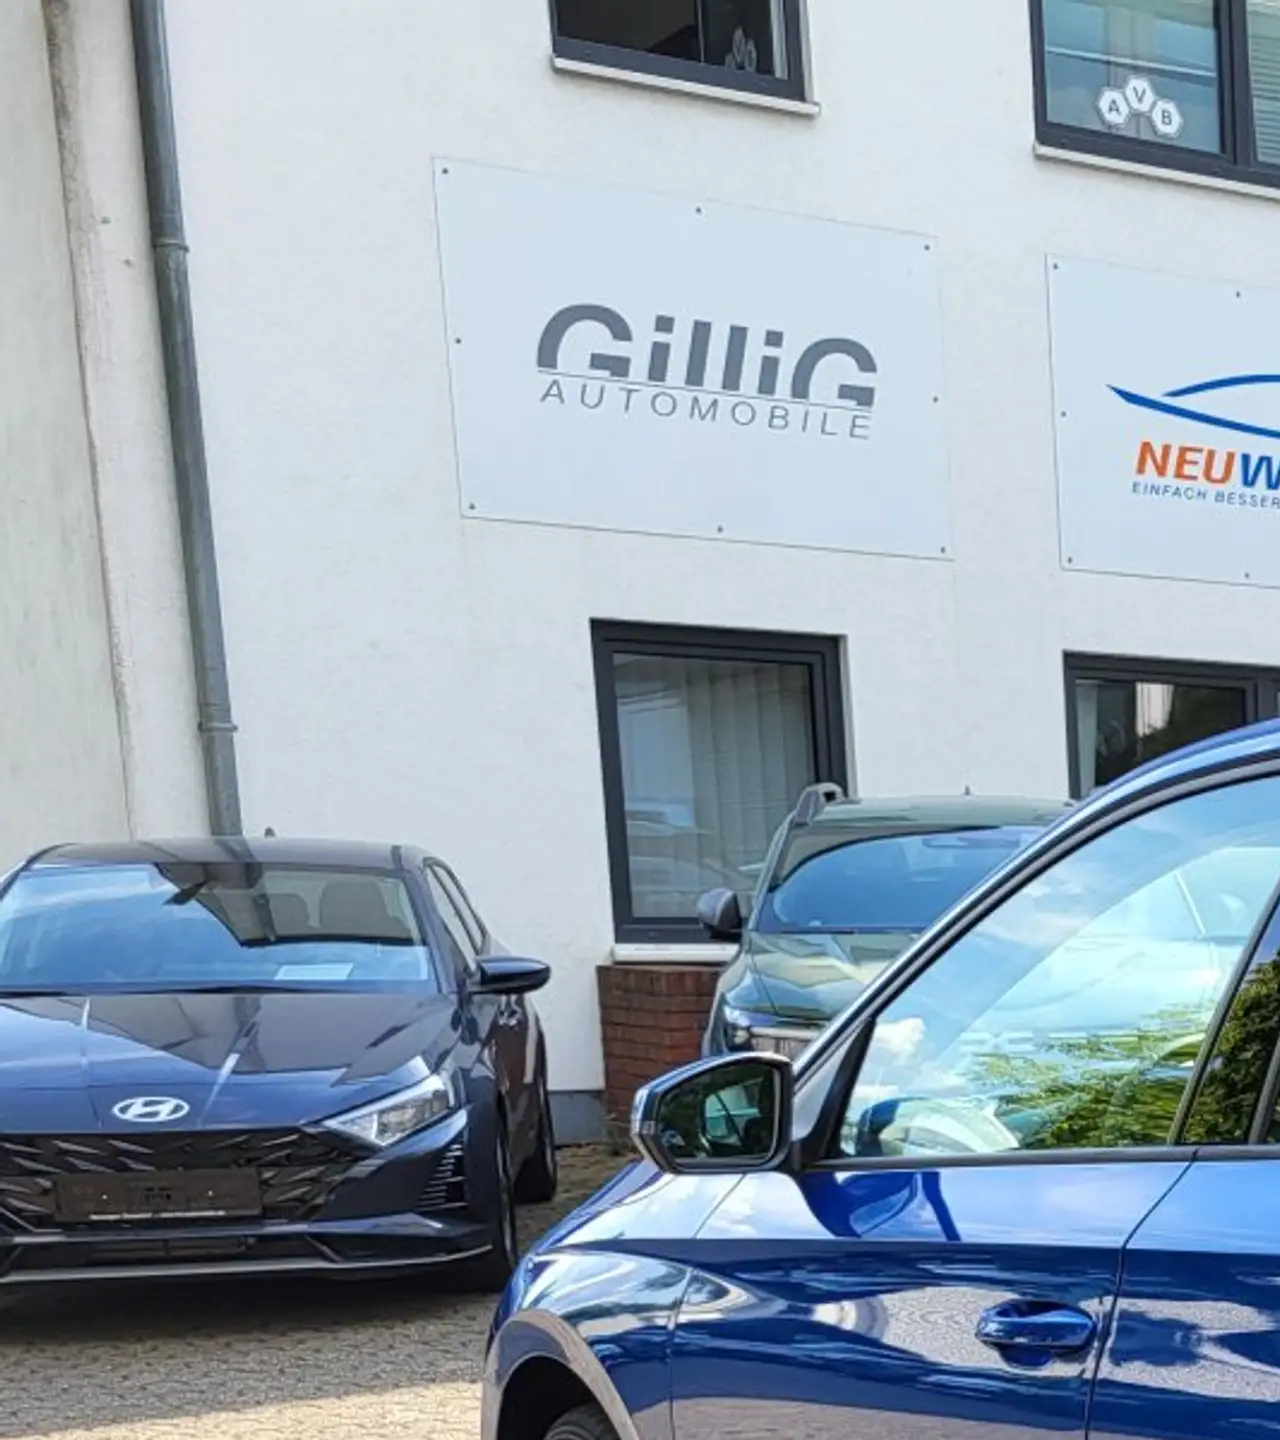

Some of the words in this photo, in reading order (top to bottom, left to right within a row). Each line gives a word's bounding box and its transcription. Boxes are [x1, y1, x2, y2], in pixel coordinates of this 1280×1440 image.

[539, 378, 873, 440] AUTOMOBILE
[1131, 481, 1207, 502] EINFACH
[1214, 490, 1280, 509] BESSER
